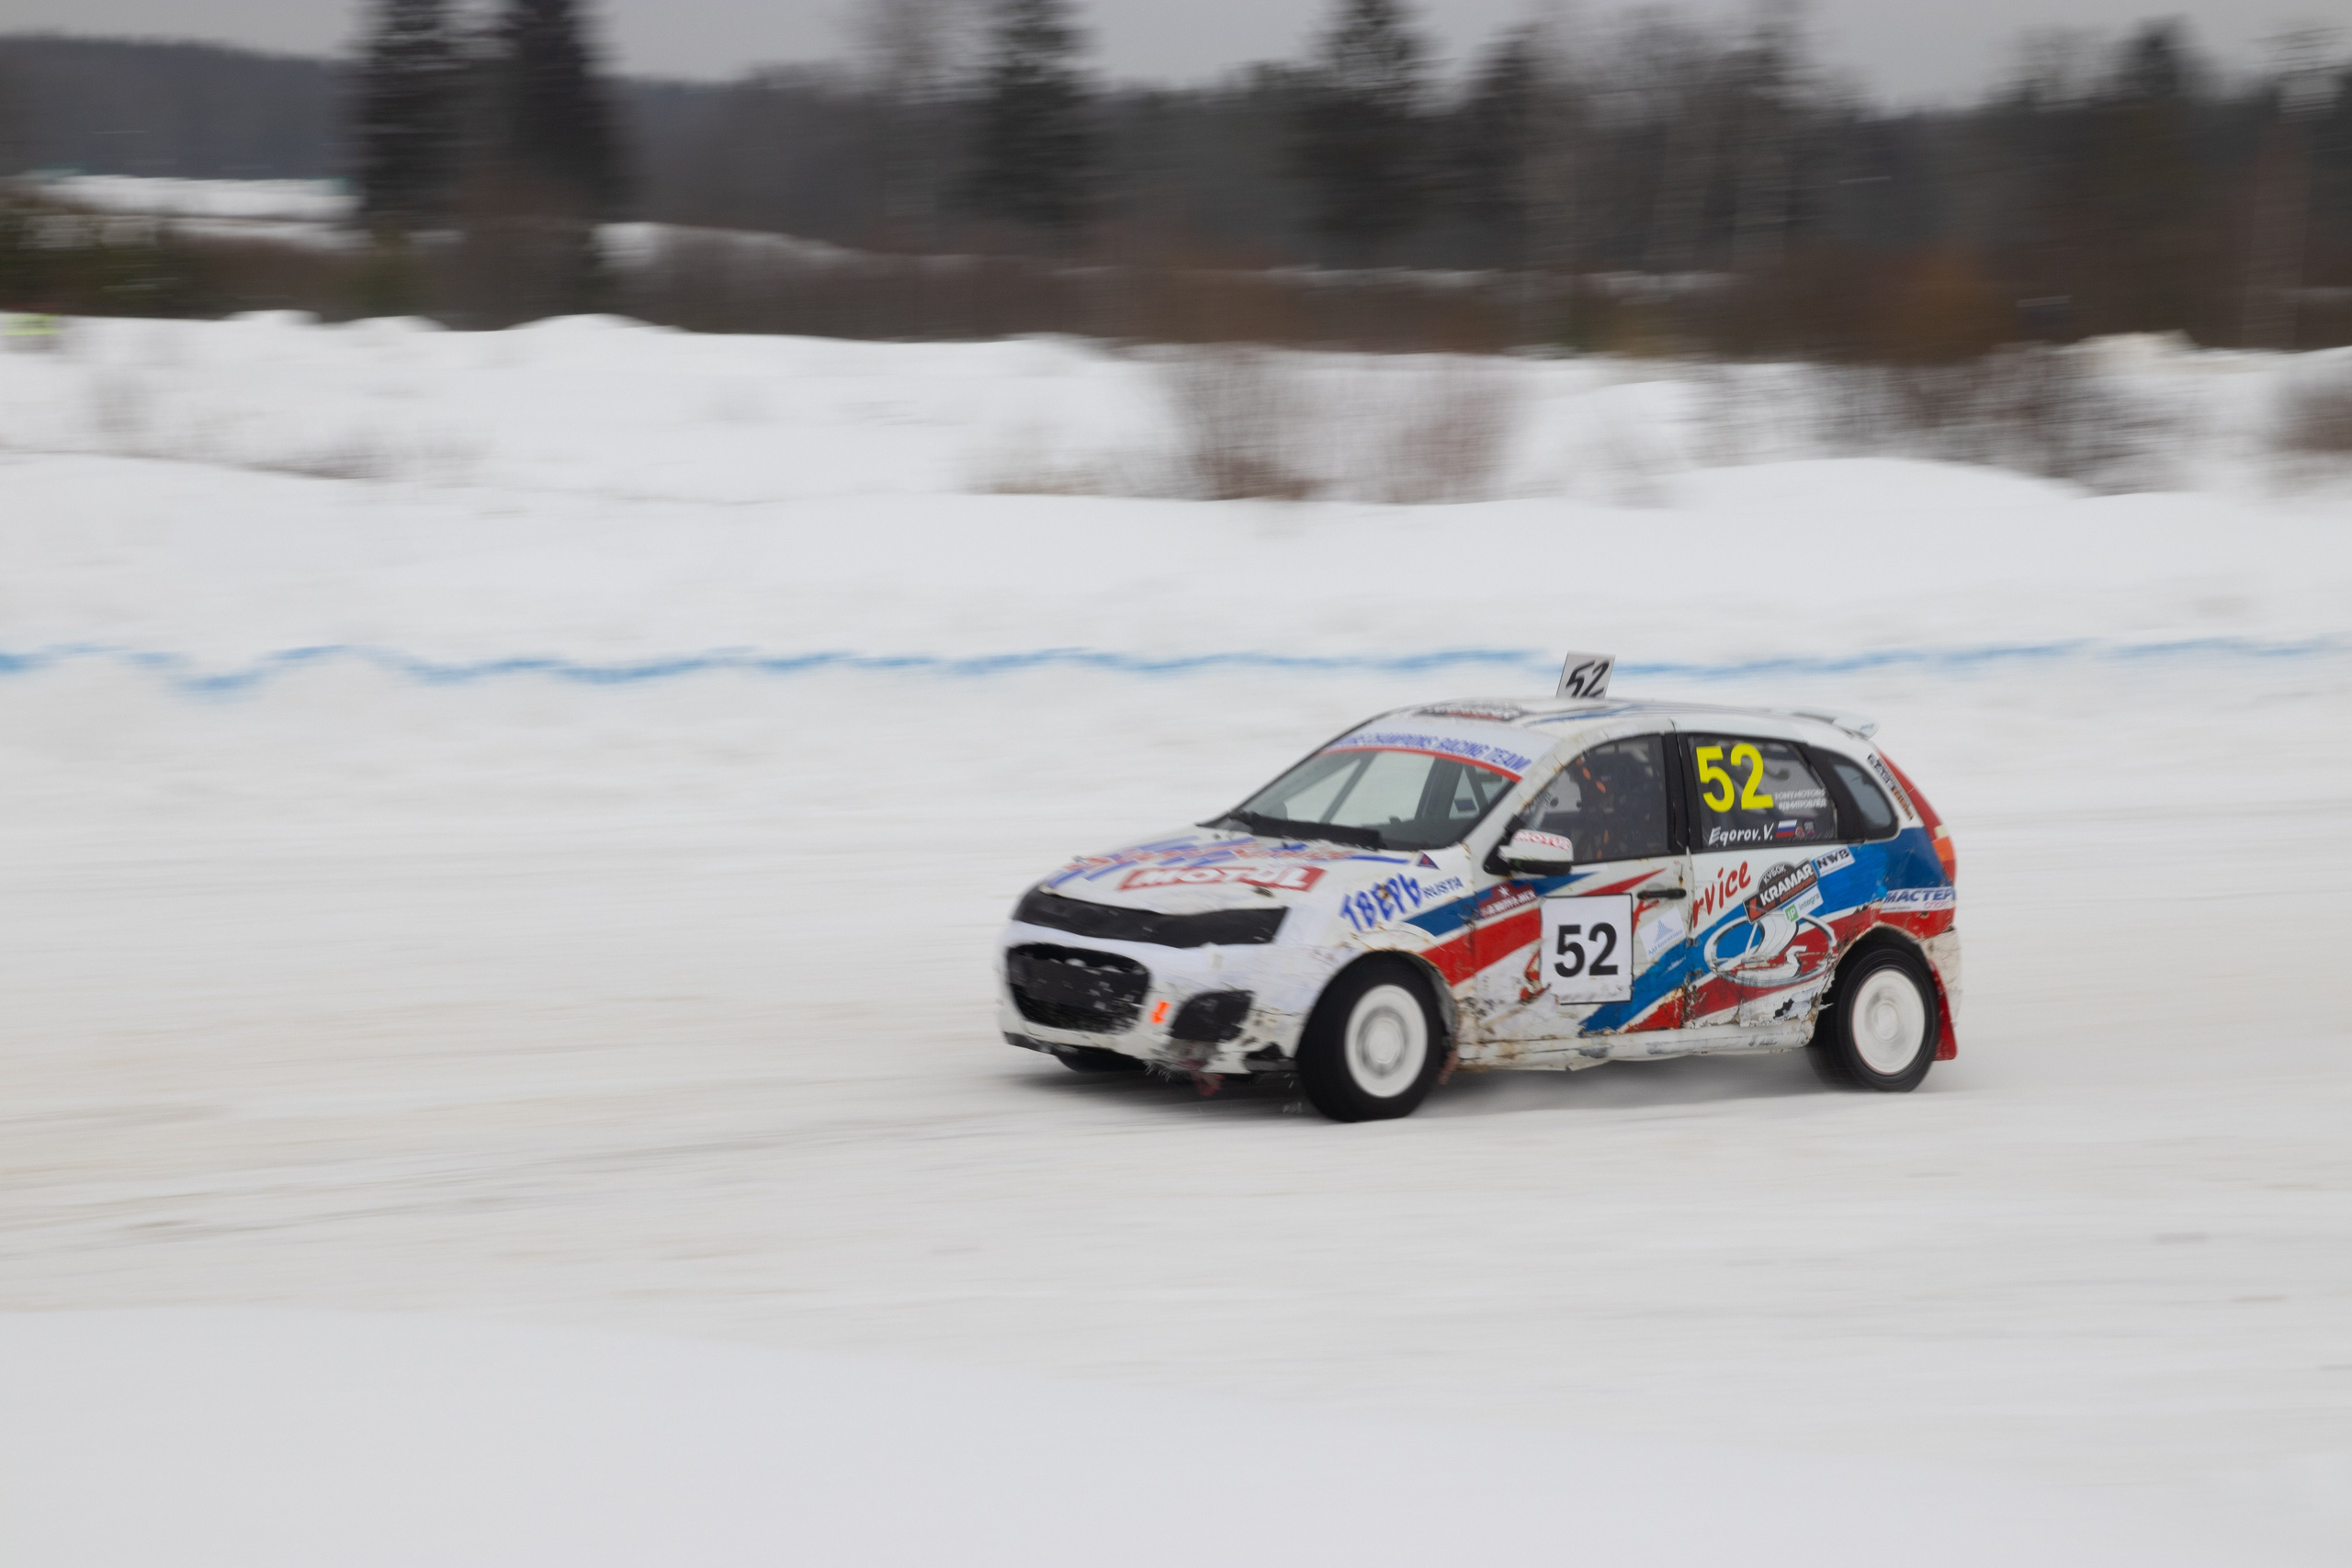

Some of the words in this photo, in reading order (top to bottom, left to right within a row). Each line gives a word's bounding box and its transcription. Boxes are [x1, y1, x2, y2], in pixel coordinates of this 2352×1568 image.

[1566, 660, 1610, 698] 52
[1696, 742, 1774, 813] 52
[1816, 849, 1850, 869] NWB
[1759, 863, 1815, 907] KRAMAR
[1555, 922, 1620, 977] 52
